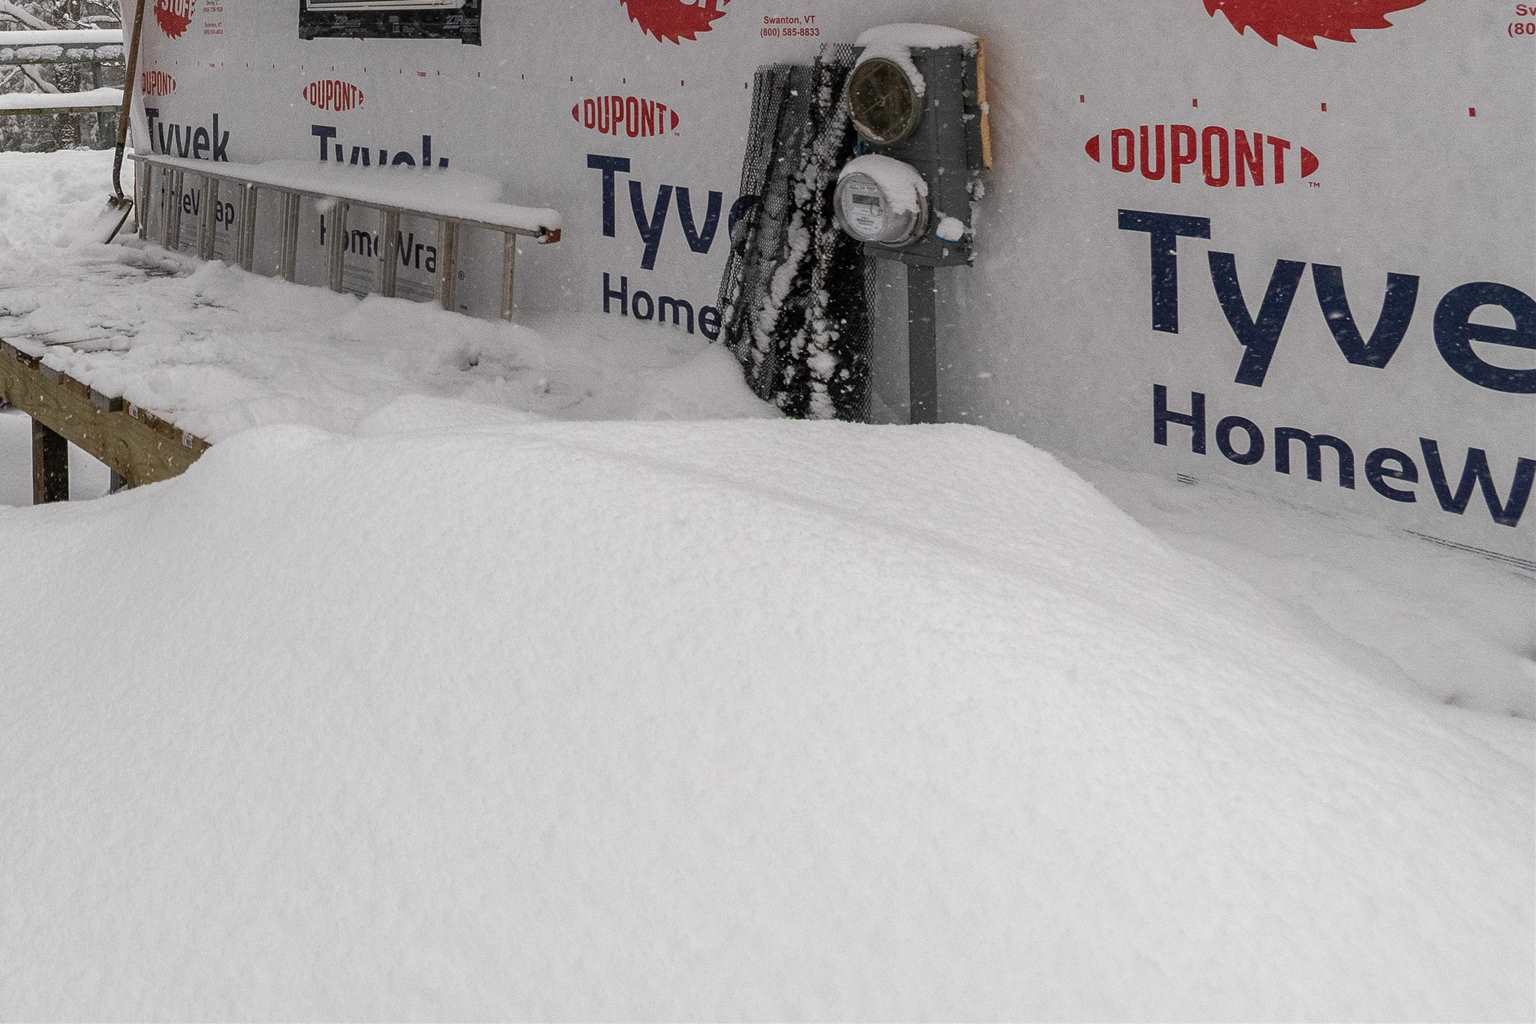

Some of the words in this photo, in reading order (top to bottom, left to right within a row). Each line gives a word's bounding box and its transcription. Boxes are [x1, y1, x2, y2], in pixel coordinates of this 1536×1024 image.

[763, 16, 802, 24] Swanton,
[310, 79, 357, 112] DUPONT
[583, 95, 667, 138] DUPONT
[1110, 124, 1292, 188] DUPONT
[603, 272, 723, 342] Home
[1118, 209, 1536, 395] Tyve
